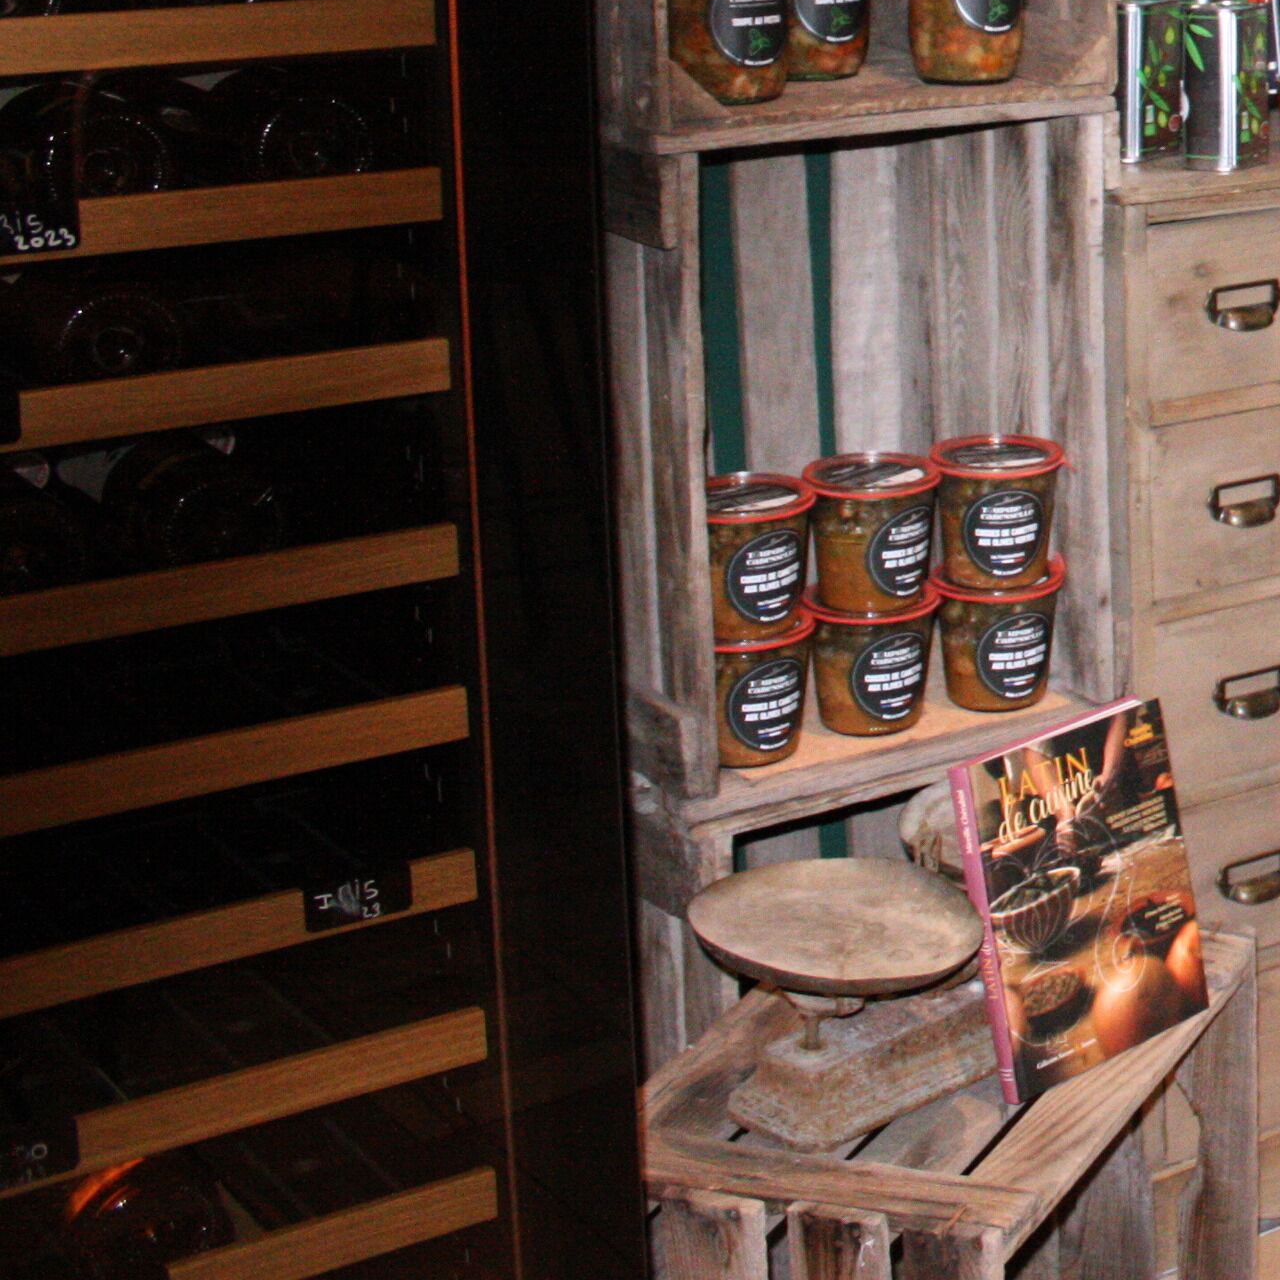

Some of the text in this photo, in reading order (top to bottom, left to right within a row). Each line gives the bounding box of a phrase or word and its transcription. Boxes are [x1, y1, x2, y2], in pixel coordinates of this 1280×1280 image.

[14, 228, 76, 250] 2023
[997, 747, 1090, 804] LATIN
[999, 794, 1026, 843] de
[1029, 769, 1093, 823] cuisine
